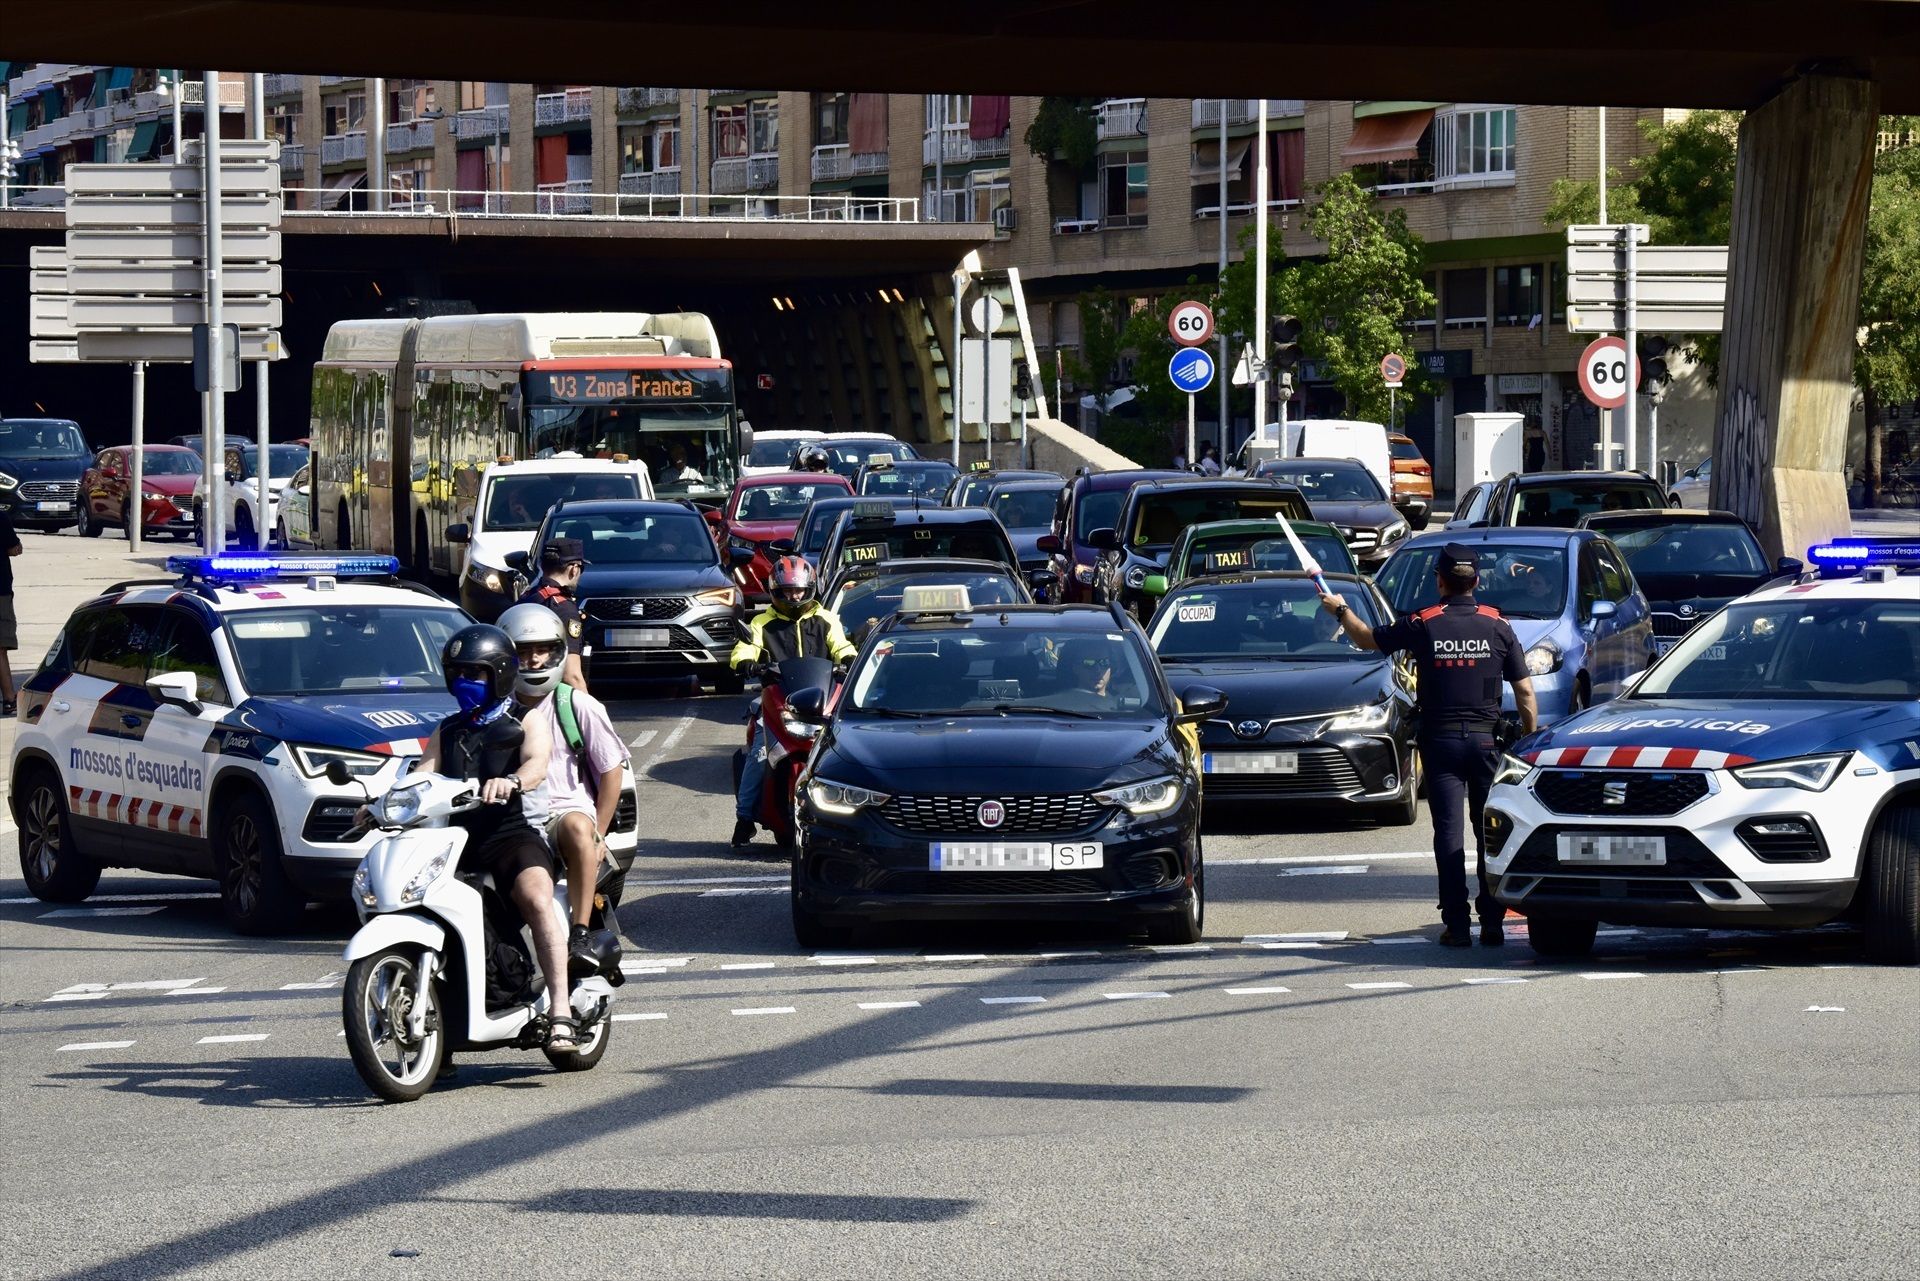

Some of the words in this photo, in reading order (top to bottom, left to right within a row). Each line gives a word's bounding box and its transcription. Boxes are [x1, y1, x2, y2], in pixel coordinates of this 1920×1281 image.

[1178, 316, 1204, 331] 60
[1592, 360, 1626, 384] 60
[553, 375, 577, 398] V3
[585, 375, 627, 398] Zona
[631, 374, 693, 397] Franca
[975, 461, 990, 469] TAXI
[863, 503, 880, 514] TAXI
[854, 546, 877, 560] TAXI
[1215, 552, 1241, 566] TAXI
[304, 561, 337, 570] d'esquadra
[917, 591, 946, 607] TAXI
[1180, 606, 1214, 620] OCUPAT
[1433, 639, 1491, 652] POLICIA
[1459, 651, 1491, 660] d'esquadra
[1619, 717, 1771, 735] policia
[227, 735, 250, 748] policia
[70, 747, 123, 778] mossos
[125, 751, 202, 792] d'esquadra
[983, 808, 999, 821] FIAT
